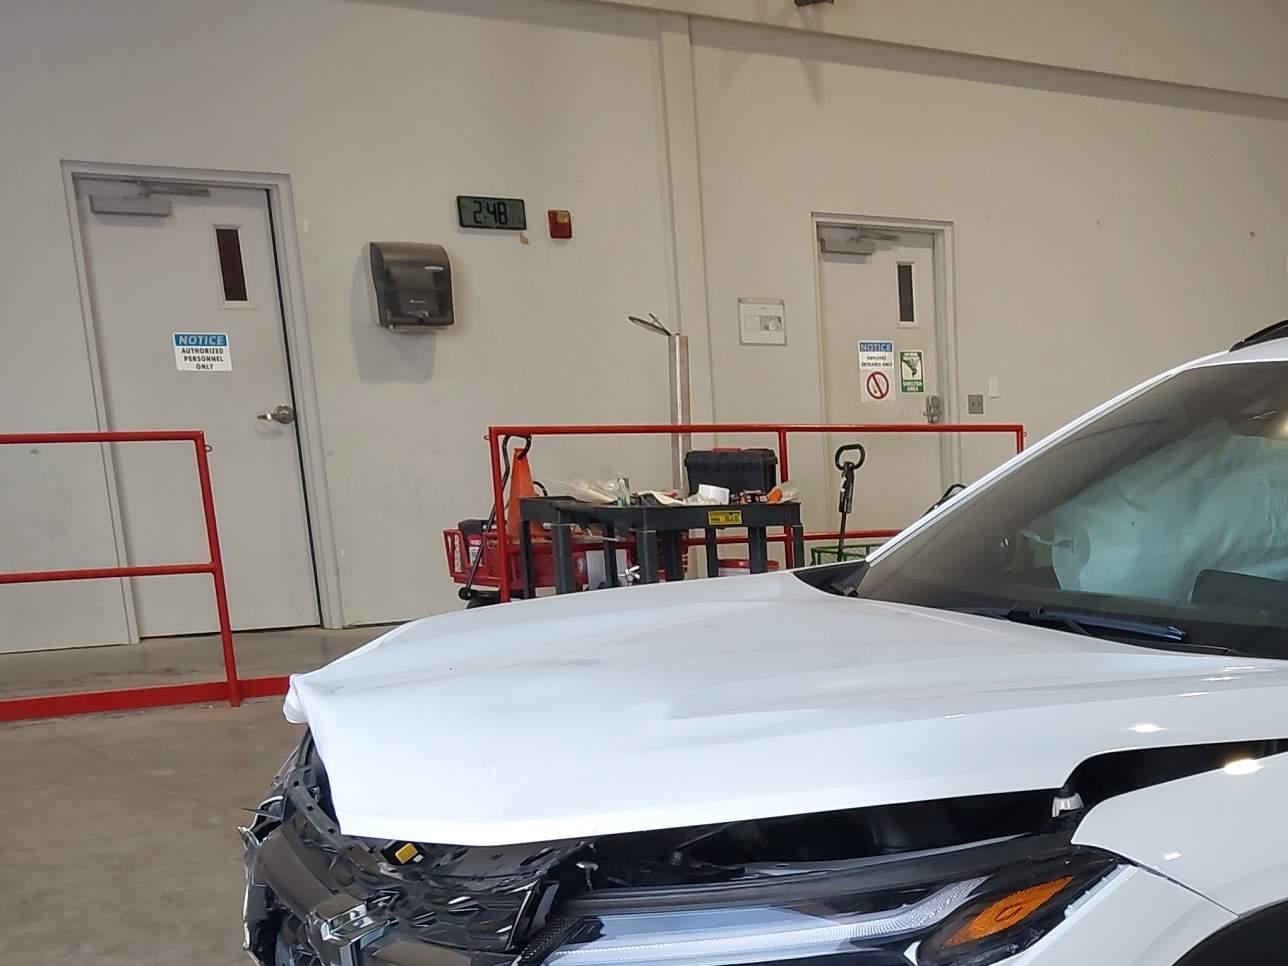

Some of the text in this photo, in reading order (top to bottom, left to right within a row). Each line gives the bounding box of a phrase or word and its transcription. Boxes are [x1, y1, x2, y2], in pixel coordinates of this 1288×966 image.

[473, 200, 508, 225] 2:48
[179, 335, 225, 345] NOTICE
[860, 343, 891, 351] NOTICE
